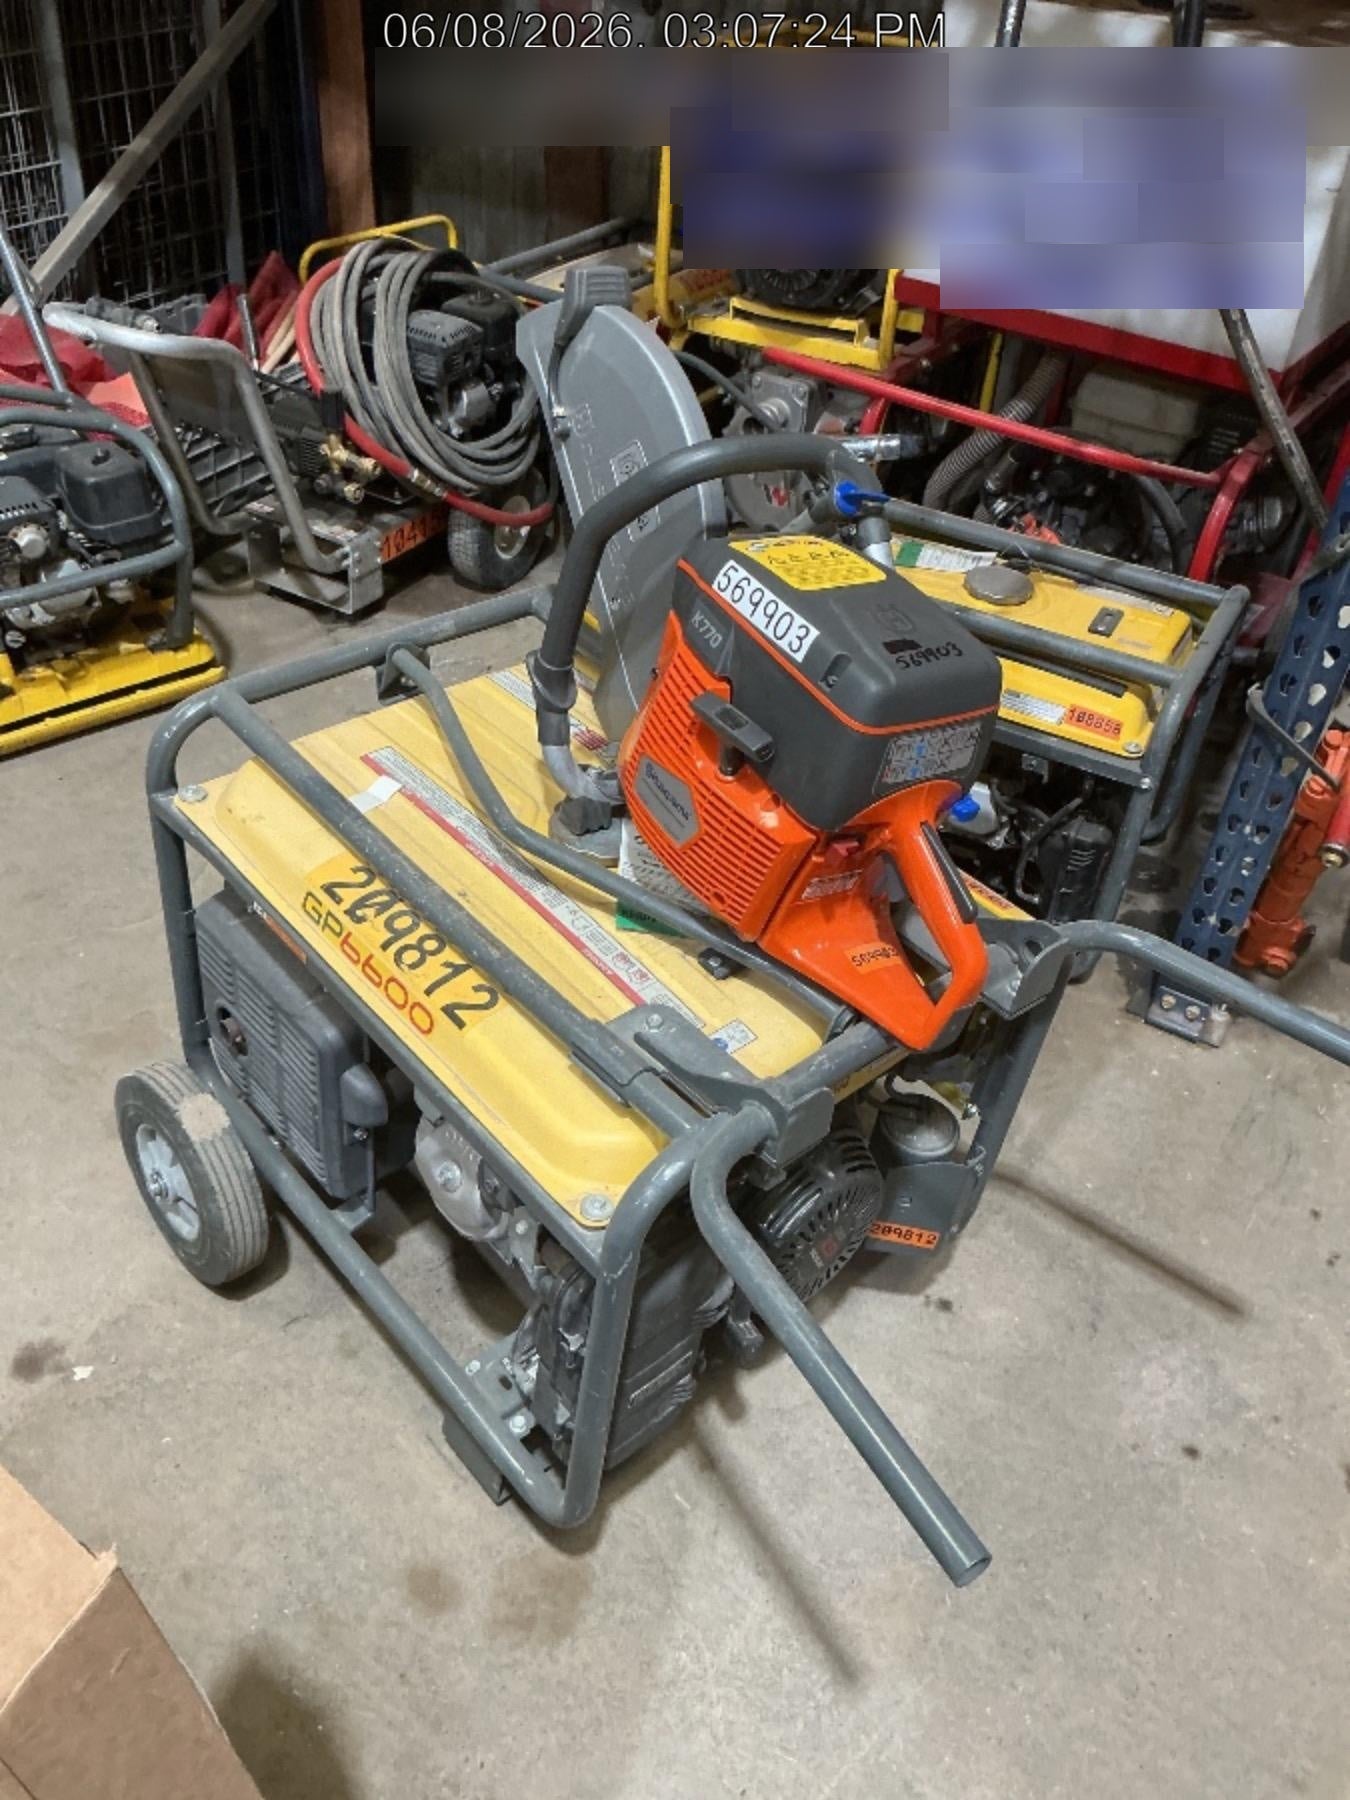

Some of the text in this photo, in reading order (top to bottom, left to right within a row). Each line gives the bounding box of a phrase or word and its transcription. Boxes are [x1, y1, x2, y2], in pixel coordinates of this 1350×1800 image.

[690, 611, 723, 649] K770
[716, 565, 811, 655] 569903
[894, 641, 964, 669] 569903
[301, 891, 435, 1036] GP6600
